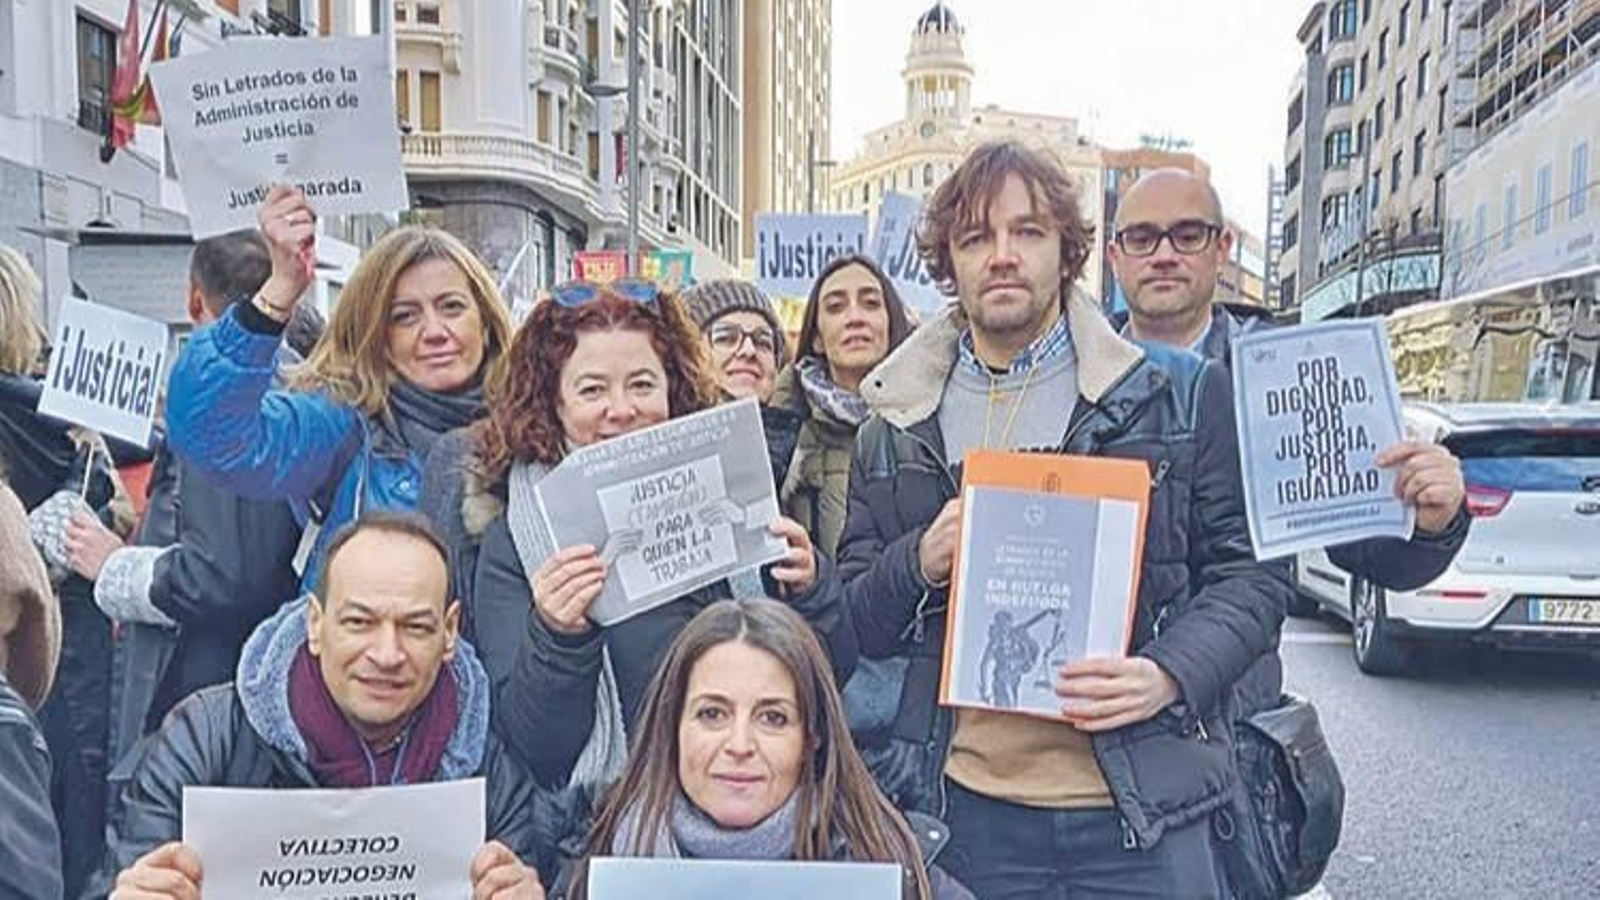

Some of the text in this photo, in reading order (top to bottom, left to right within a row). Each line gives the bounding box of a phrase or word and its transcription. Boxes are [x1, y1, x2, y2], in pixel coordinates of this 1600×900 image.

[191, 65, 358, 101] Sin Letrados de la
[194, 92, 359, 127] Administración de
[242, 120, 315, 144] Justicia
[52, 325, 162, 418] ¡Justicia!
[1297, 356, 1340, 386] POR
[1266, 376, 1374, 417] DIGNIDAD,
[1302, 405, 1344, 436] POR
[1275, 424, 1377, 461] JUSTICIA,
[1305, 450, 1347, 479] POR
[1277, 469, 1379, 505] IGUALDAD
[656, 512, 694, 538] PARA
[692, 527, 713, 547] LA
[279, 835, 400, 857] COLECTIVA
[259, 863, 416, 891] NEGOCIACIÓN
